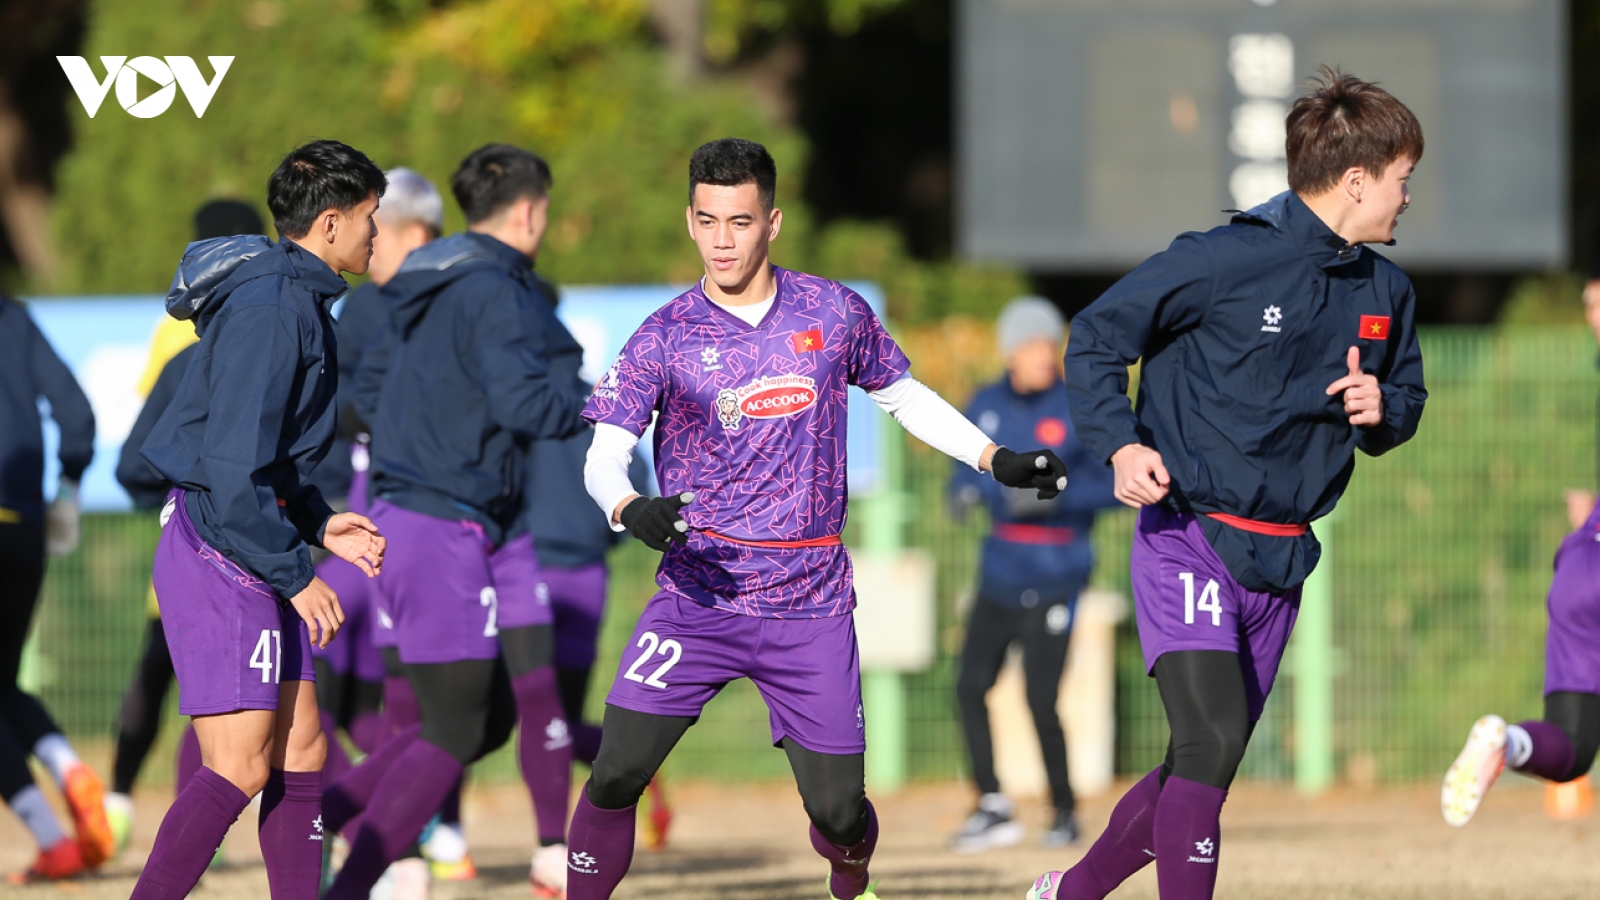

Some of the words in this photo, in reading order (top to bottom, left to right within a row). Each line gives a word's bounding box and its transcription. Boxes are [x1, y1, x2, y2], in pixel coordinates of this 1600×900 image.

[737, 382, 762, 398] Cook
[763, 374, 813, 388] happiness
[1178, 572, 1223, 627] 14
[249, 628, 282, 685] 41
[623, 631, 683, 690] 22
